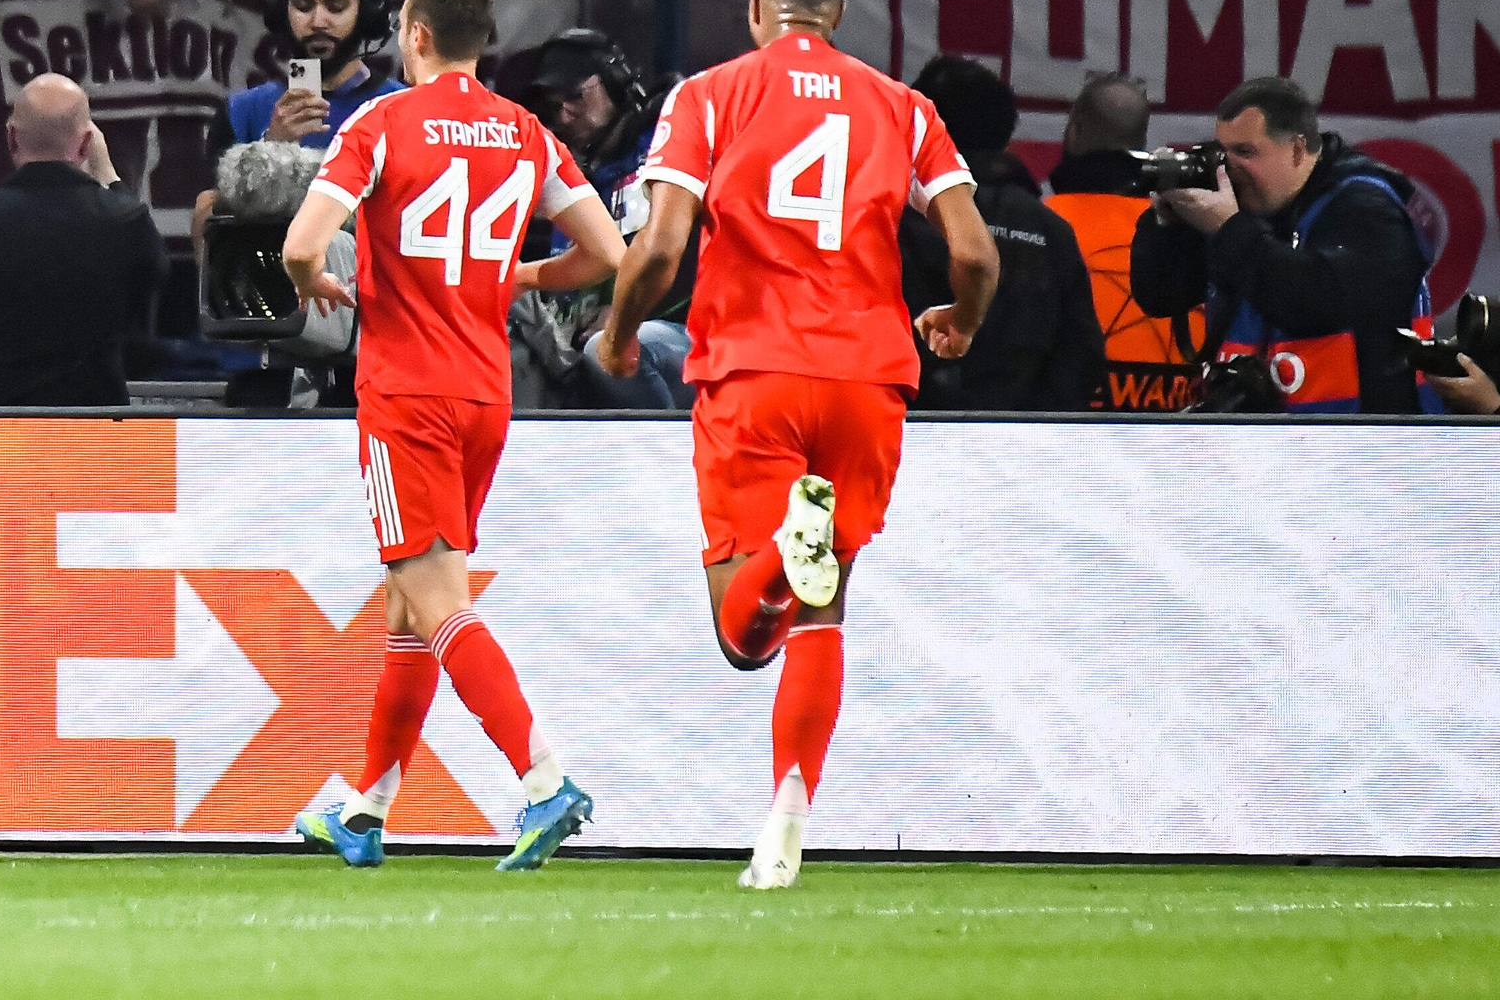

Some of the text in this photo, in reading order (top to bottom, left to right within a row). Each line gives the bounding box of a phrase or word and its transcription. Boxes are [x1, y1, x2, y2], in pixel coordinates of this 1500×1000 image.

[788, 70, 841, 101] TAH
[423, 117, 522, 150] STANIŠIĆ
[400, 156, 536, 286] 44
[767, 112, 850, 251] 4
